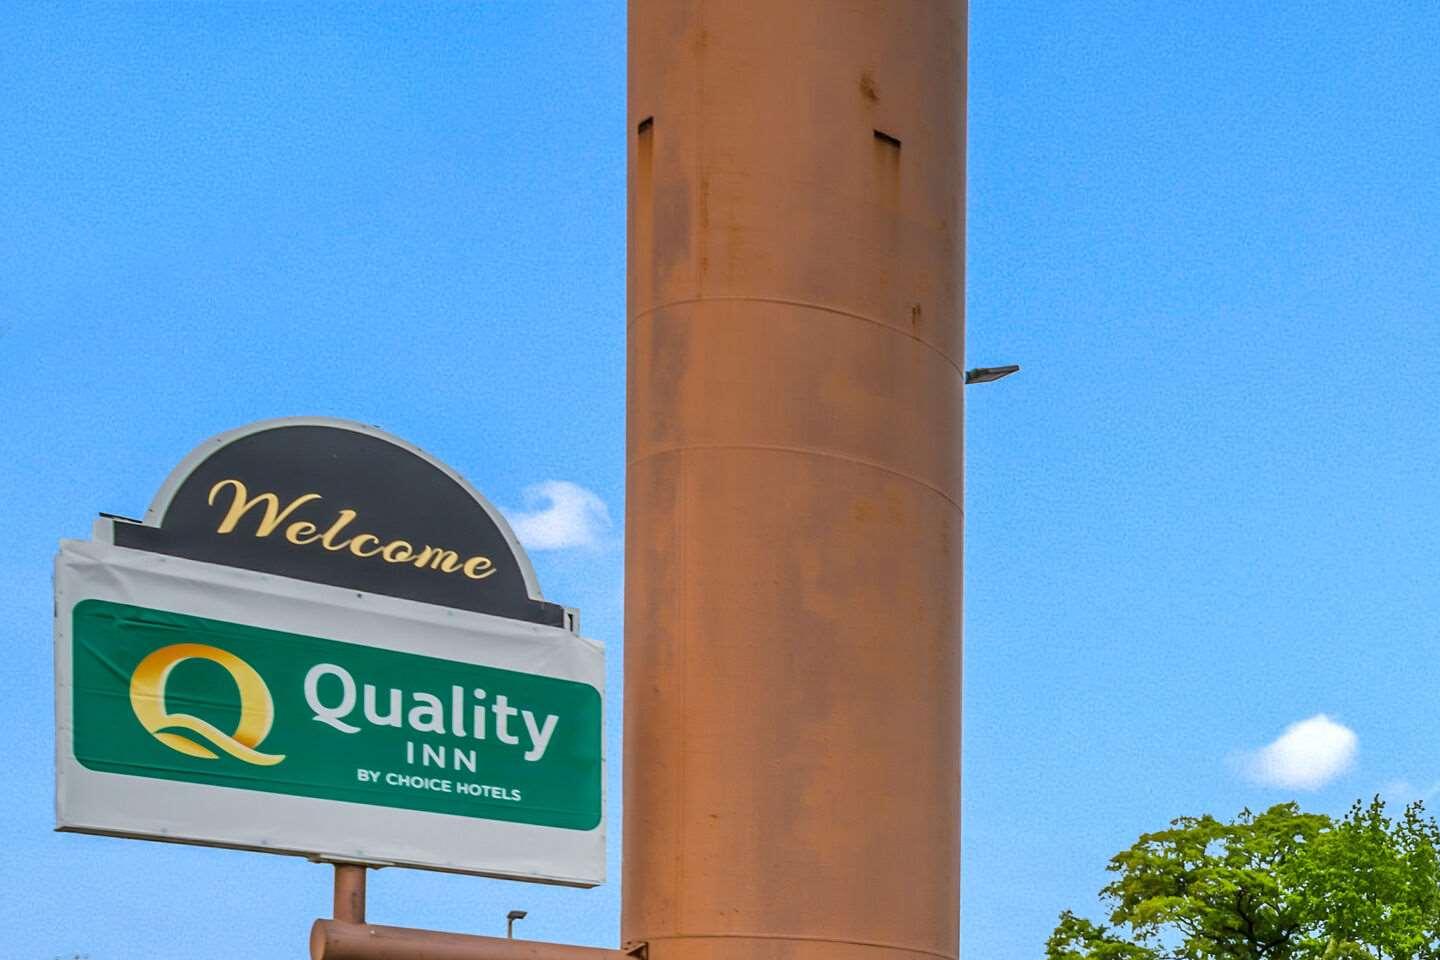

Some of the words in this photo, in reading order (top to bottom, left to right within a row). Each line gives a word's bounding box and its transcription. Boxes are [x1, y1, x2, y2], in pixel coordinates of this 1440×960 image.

[207, 478, 497, 581] Welcome
[303, 662, 560, 762] Quality
[357, 768, 380, 783] BY
[386, 773, 452, 793] CHOICE
[456, 782, 521, 801] HOTELS
[407, 741, 477, 773] INN
